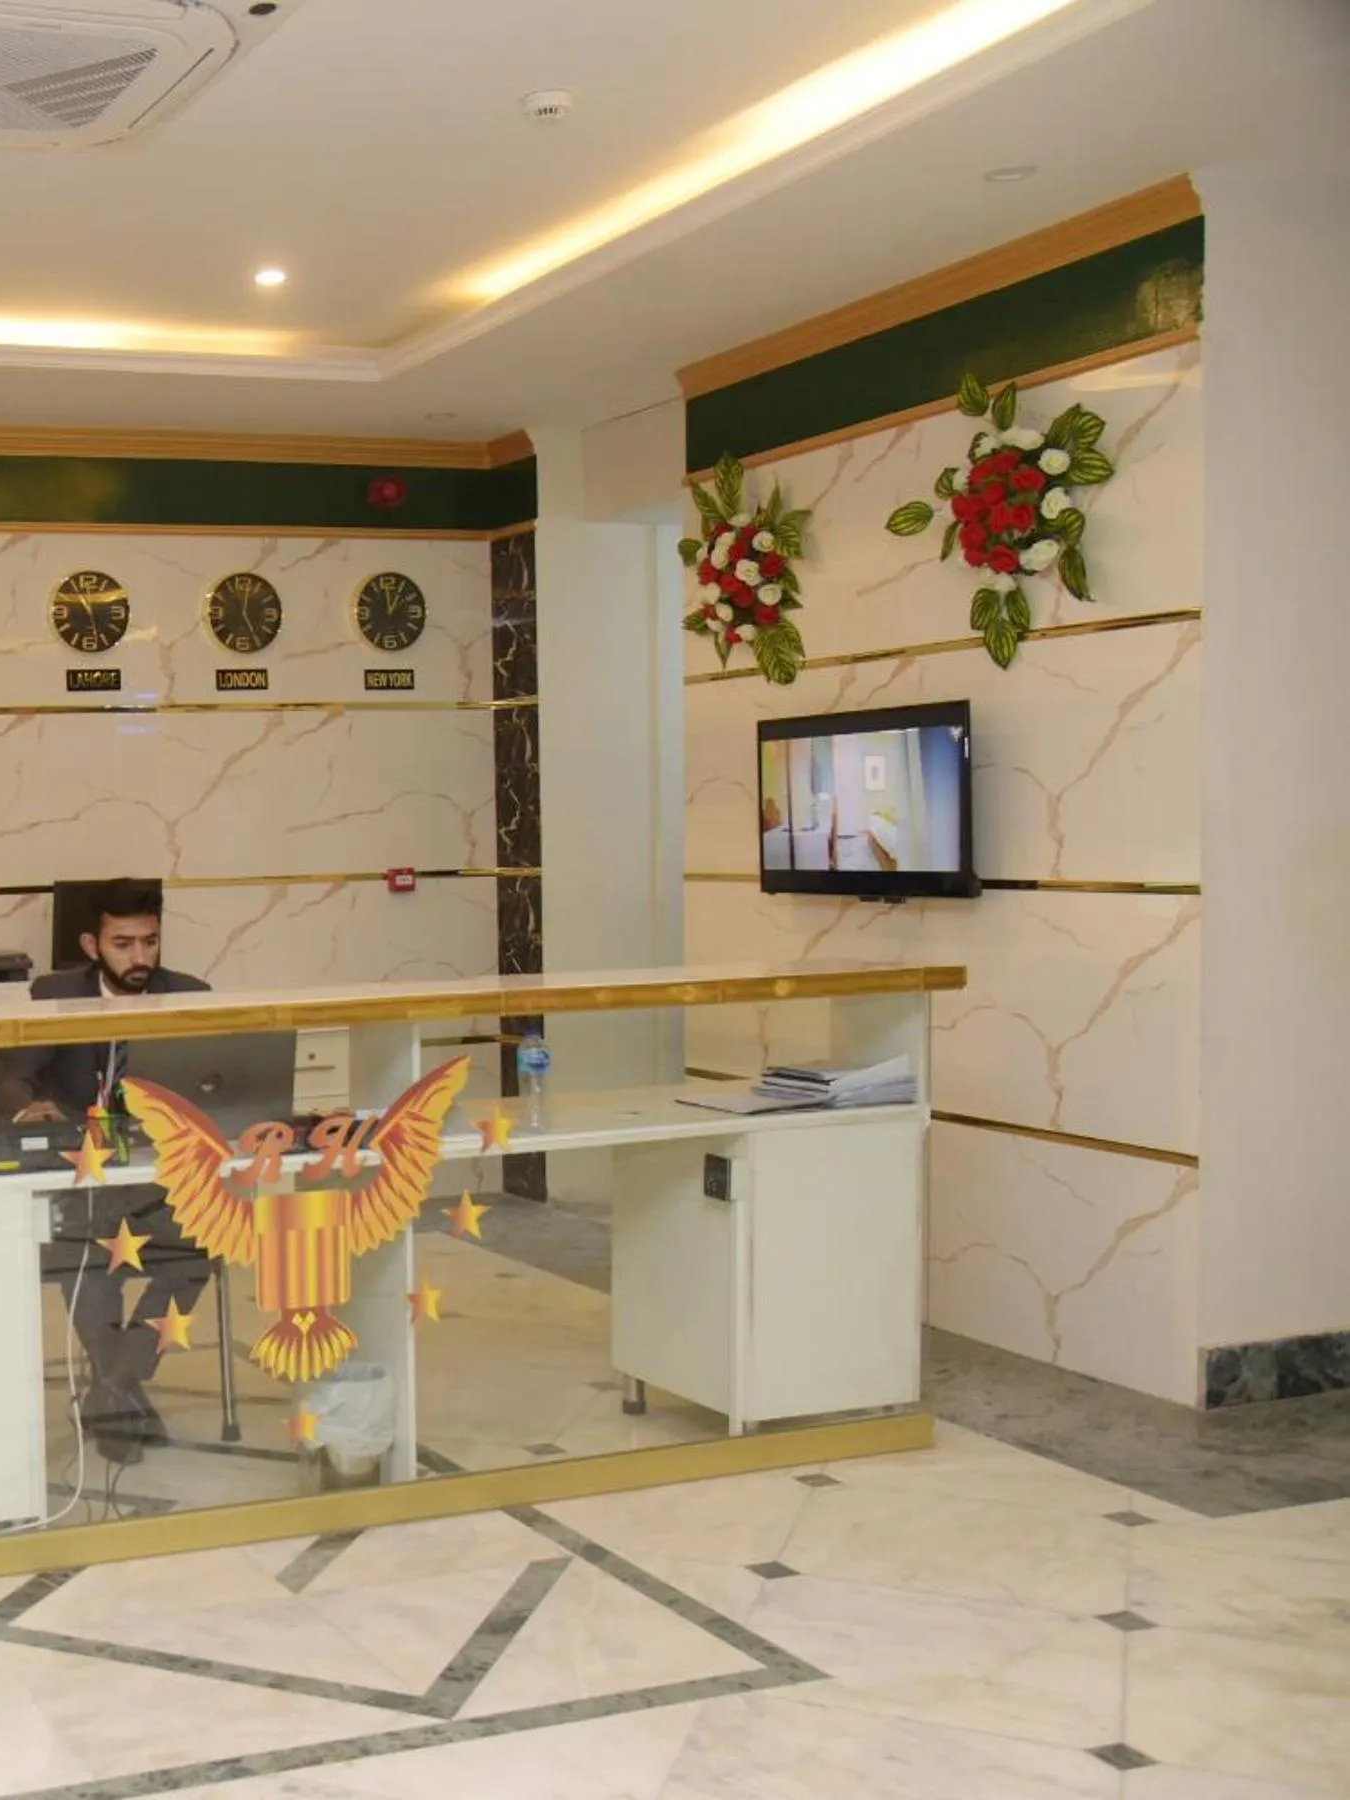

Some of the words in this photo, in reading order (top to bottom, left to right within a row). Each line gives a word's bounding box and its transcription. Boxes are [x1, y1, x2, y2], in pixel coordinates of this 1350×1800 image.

[80, 575, 97, 588] 12
[236, 577, 251, 590] 12
[379, 577, 396, 589] 12
[54, 606, 67, 619] 9
[111, 606, 125, 619] 3
[210, 607, 223, 620] 9
[265, 608, 278, 621] 3
[357, 606, 369, 619] 9
[408, 605, 421, 619] 3
[82, 636, 96, 650] 6
[236, 637, 250, 650] 6
[383, 635, 396, 648] 6
[218, 672, 266, 688] LONDON
[367, 672, 388, 687] NEW
[388, 671, 413, 687] YORK
